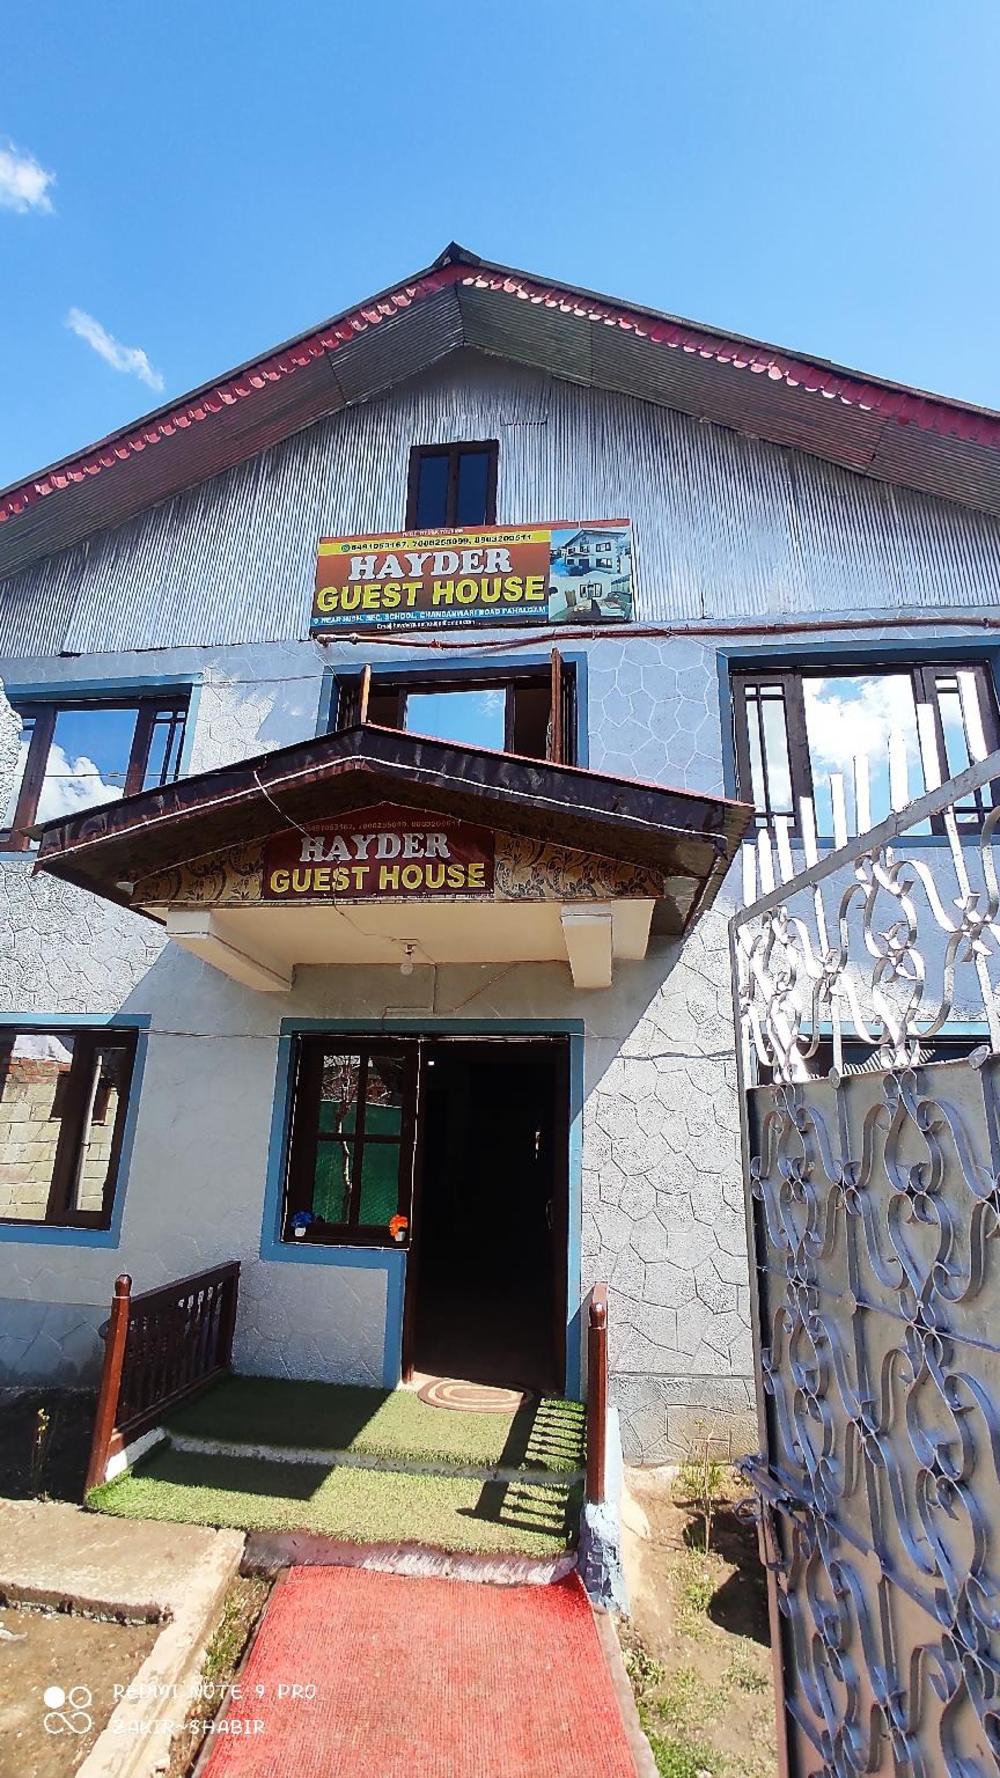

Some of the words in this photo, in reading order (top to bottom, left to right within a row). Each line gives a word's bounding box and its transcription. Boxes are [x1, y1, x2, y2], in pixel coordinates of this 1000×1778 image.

[348, 546, 513, 581] HAYDER
[316, 581, 422, 612] GUEST
[432, 575, 545, 605] HOUSE
[299, 832, 451, 862] HAYDER
[270, 866, 370, 893] GUEST
[379, 863, 486, 890] HOUSE
